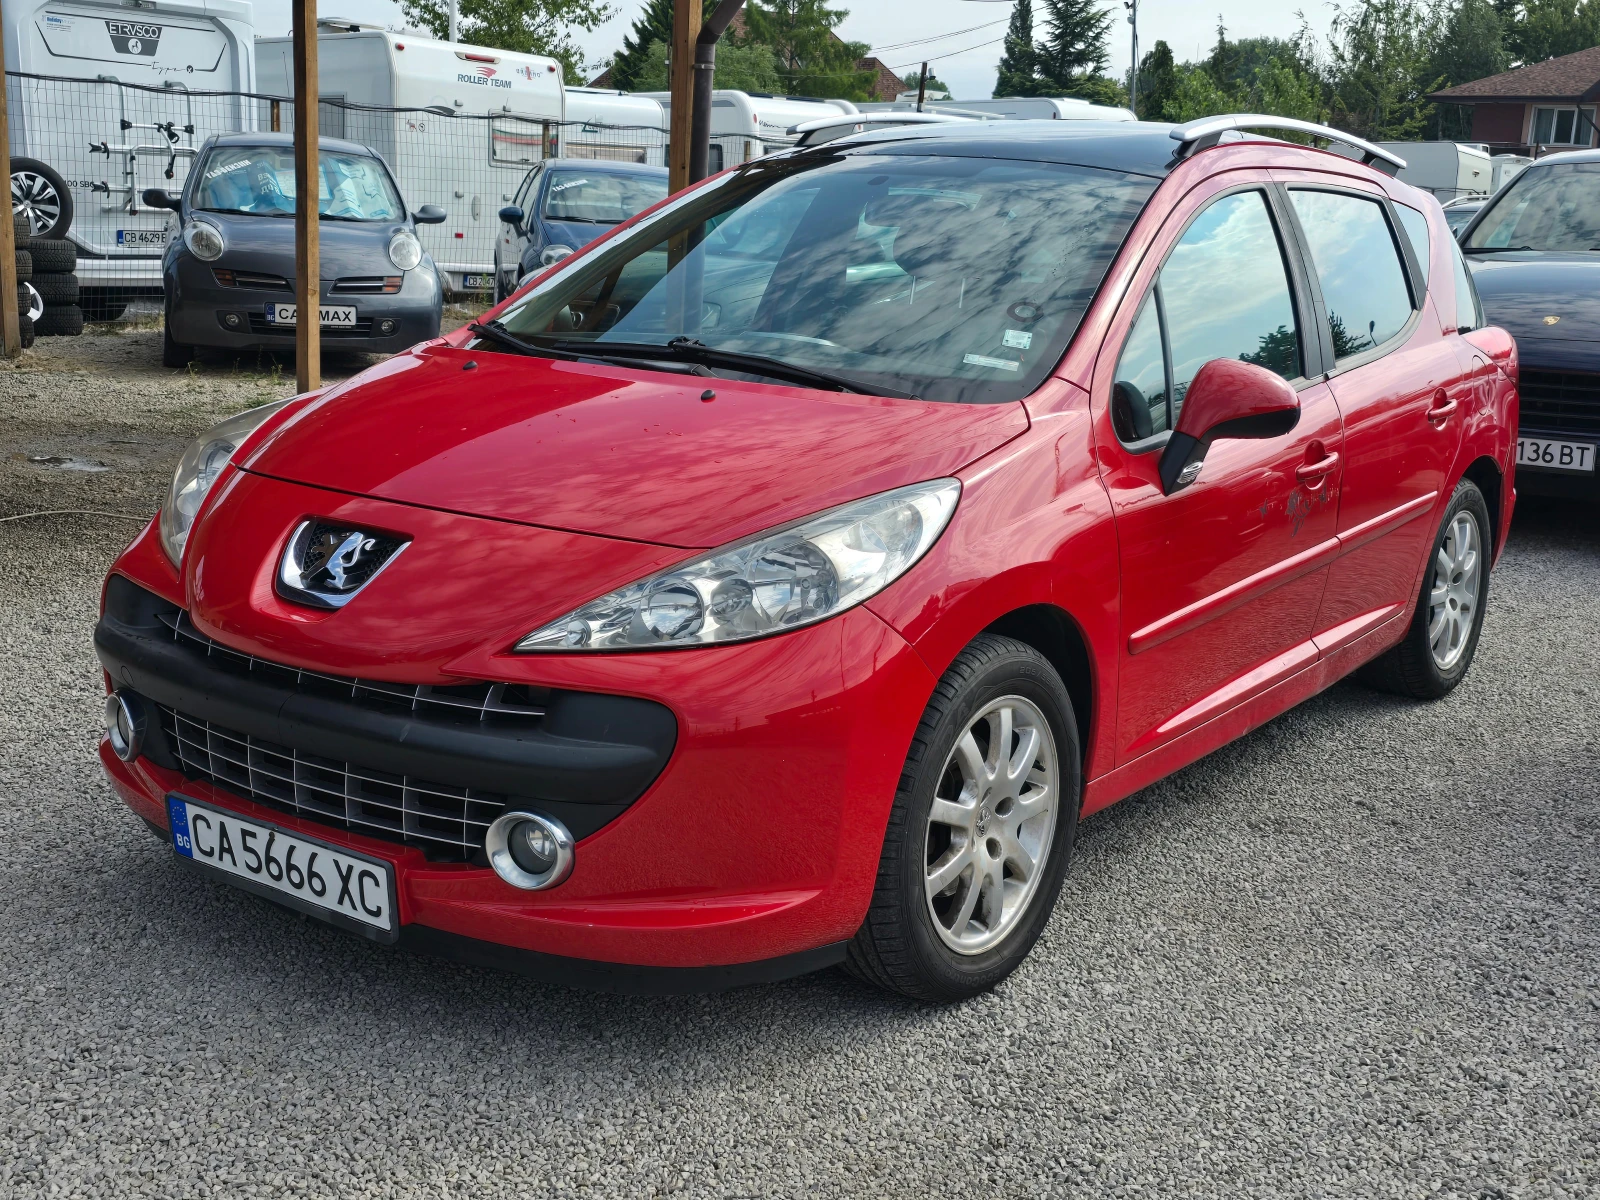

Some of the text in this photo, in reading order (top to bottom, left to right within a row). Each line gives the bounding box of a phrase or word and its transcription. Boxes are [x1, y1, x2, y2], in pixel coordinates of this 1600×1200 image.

[457, 73, 512, 89] ROLLER TEAM
[64, 179, 78, 188] 00
[138, 232, 160, 243] 4629
[319, 310, 352, 322] MAX
[1518, 440, 1590, 467] 136 BT
[176, 833, 191, 849] BG
